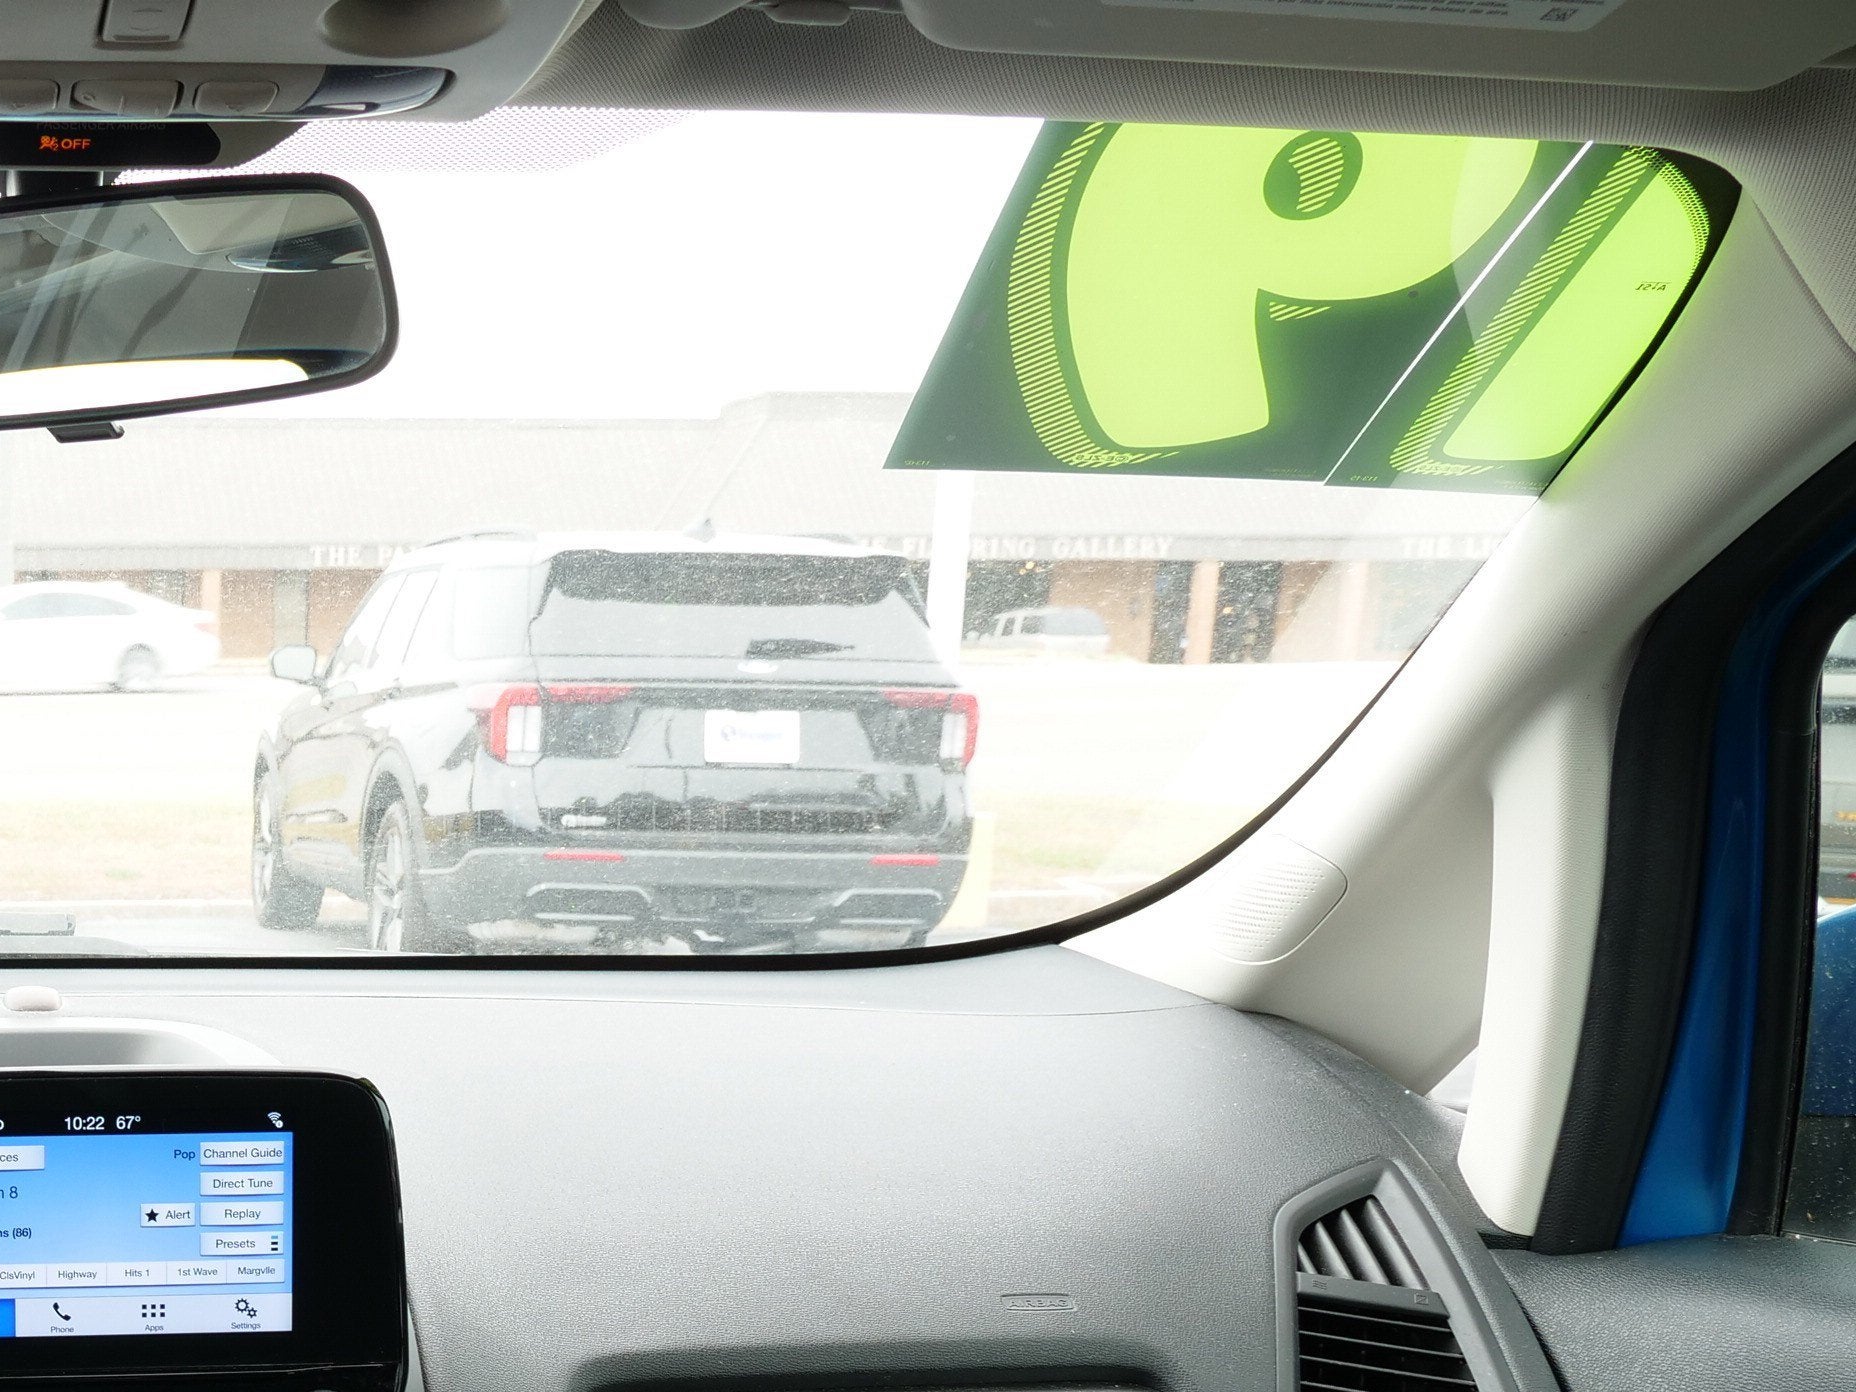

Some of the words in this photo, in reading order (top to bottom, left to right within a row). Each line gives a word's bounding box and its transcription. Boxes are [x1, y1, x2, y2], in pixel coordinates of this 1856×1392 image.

[61, 138, 91, 150] OFF
[902, 535, 1037, 560] FLRING
[1051, 534, 1173, 560] GALLERY
[309, 546, 362, 568] THE
[64, 1116, 105, 1131] 10:22
[115, 1115, 141, 1130] 67°
[173, 1149, 196, 1161] Pop
[203, 1148, 248, 1160] Channel
[250, 1146, 283, 1159] Guide
[212, 1178, 244, 1189] Direct
[247, 1177, 274, 1188] Tune
[9, 1185, 19, 1199] 8
[165, 1209, 191, 1220] Alert
[224, 1208, 261, 1220] Replay
[12, 1227, 32, 1240] (86)
[215, 1238, 256, 1249] Presets
[0, 1270, 36, 1281] ClsVinyl
[57, 1270, 97, 1280] Highway
[124, 1268, 142, 1277] Hits
[177, 1267, 191, 1276] 1st
[193, 1267, 218, 1276] Wave
[1008, 1298, 1067, 1309] AIRBAG
[50, 1325, 75, 1334] Phone
[144, 1323, 164, 1332] Apps
[230, 1321, 261, 1331] Settings
